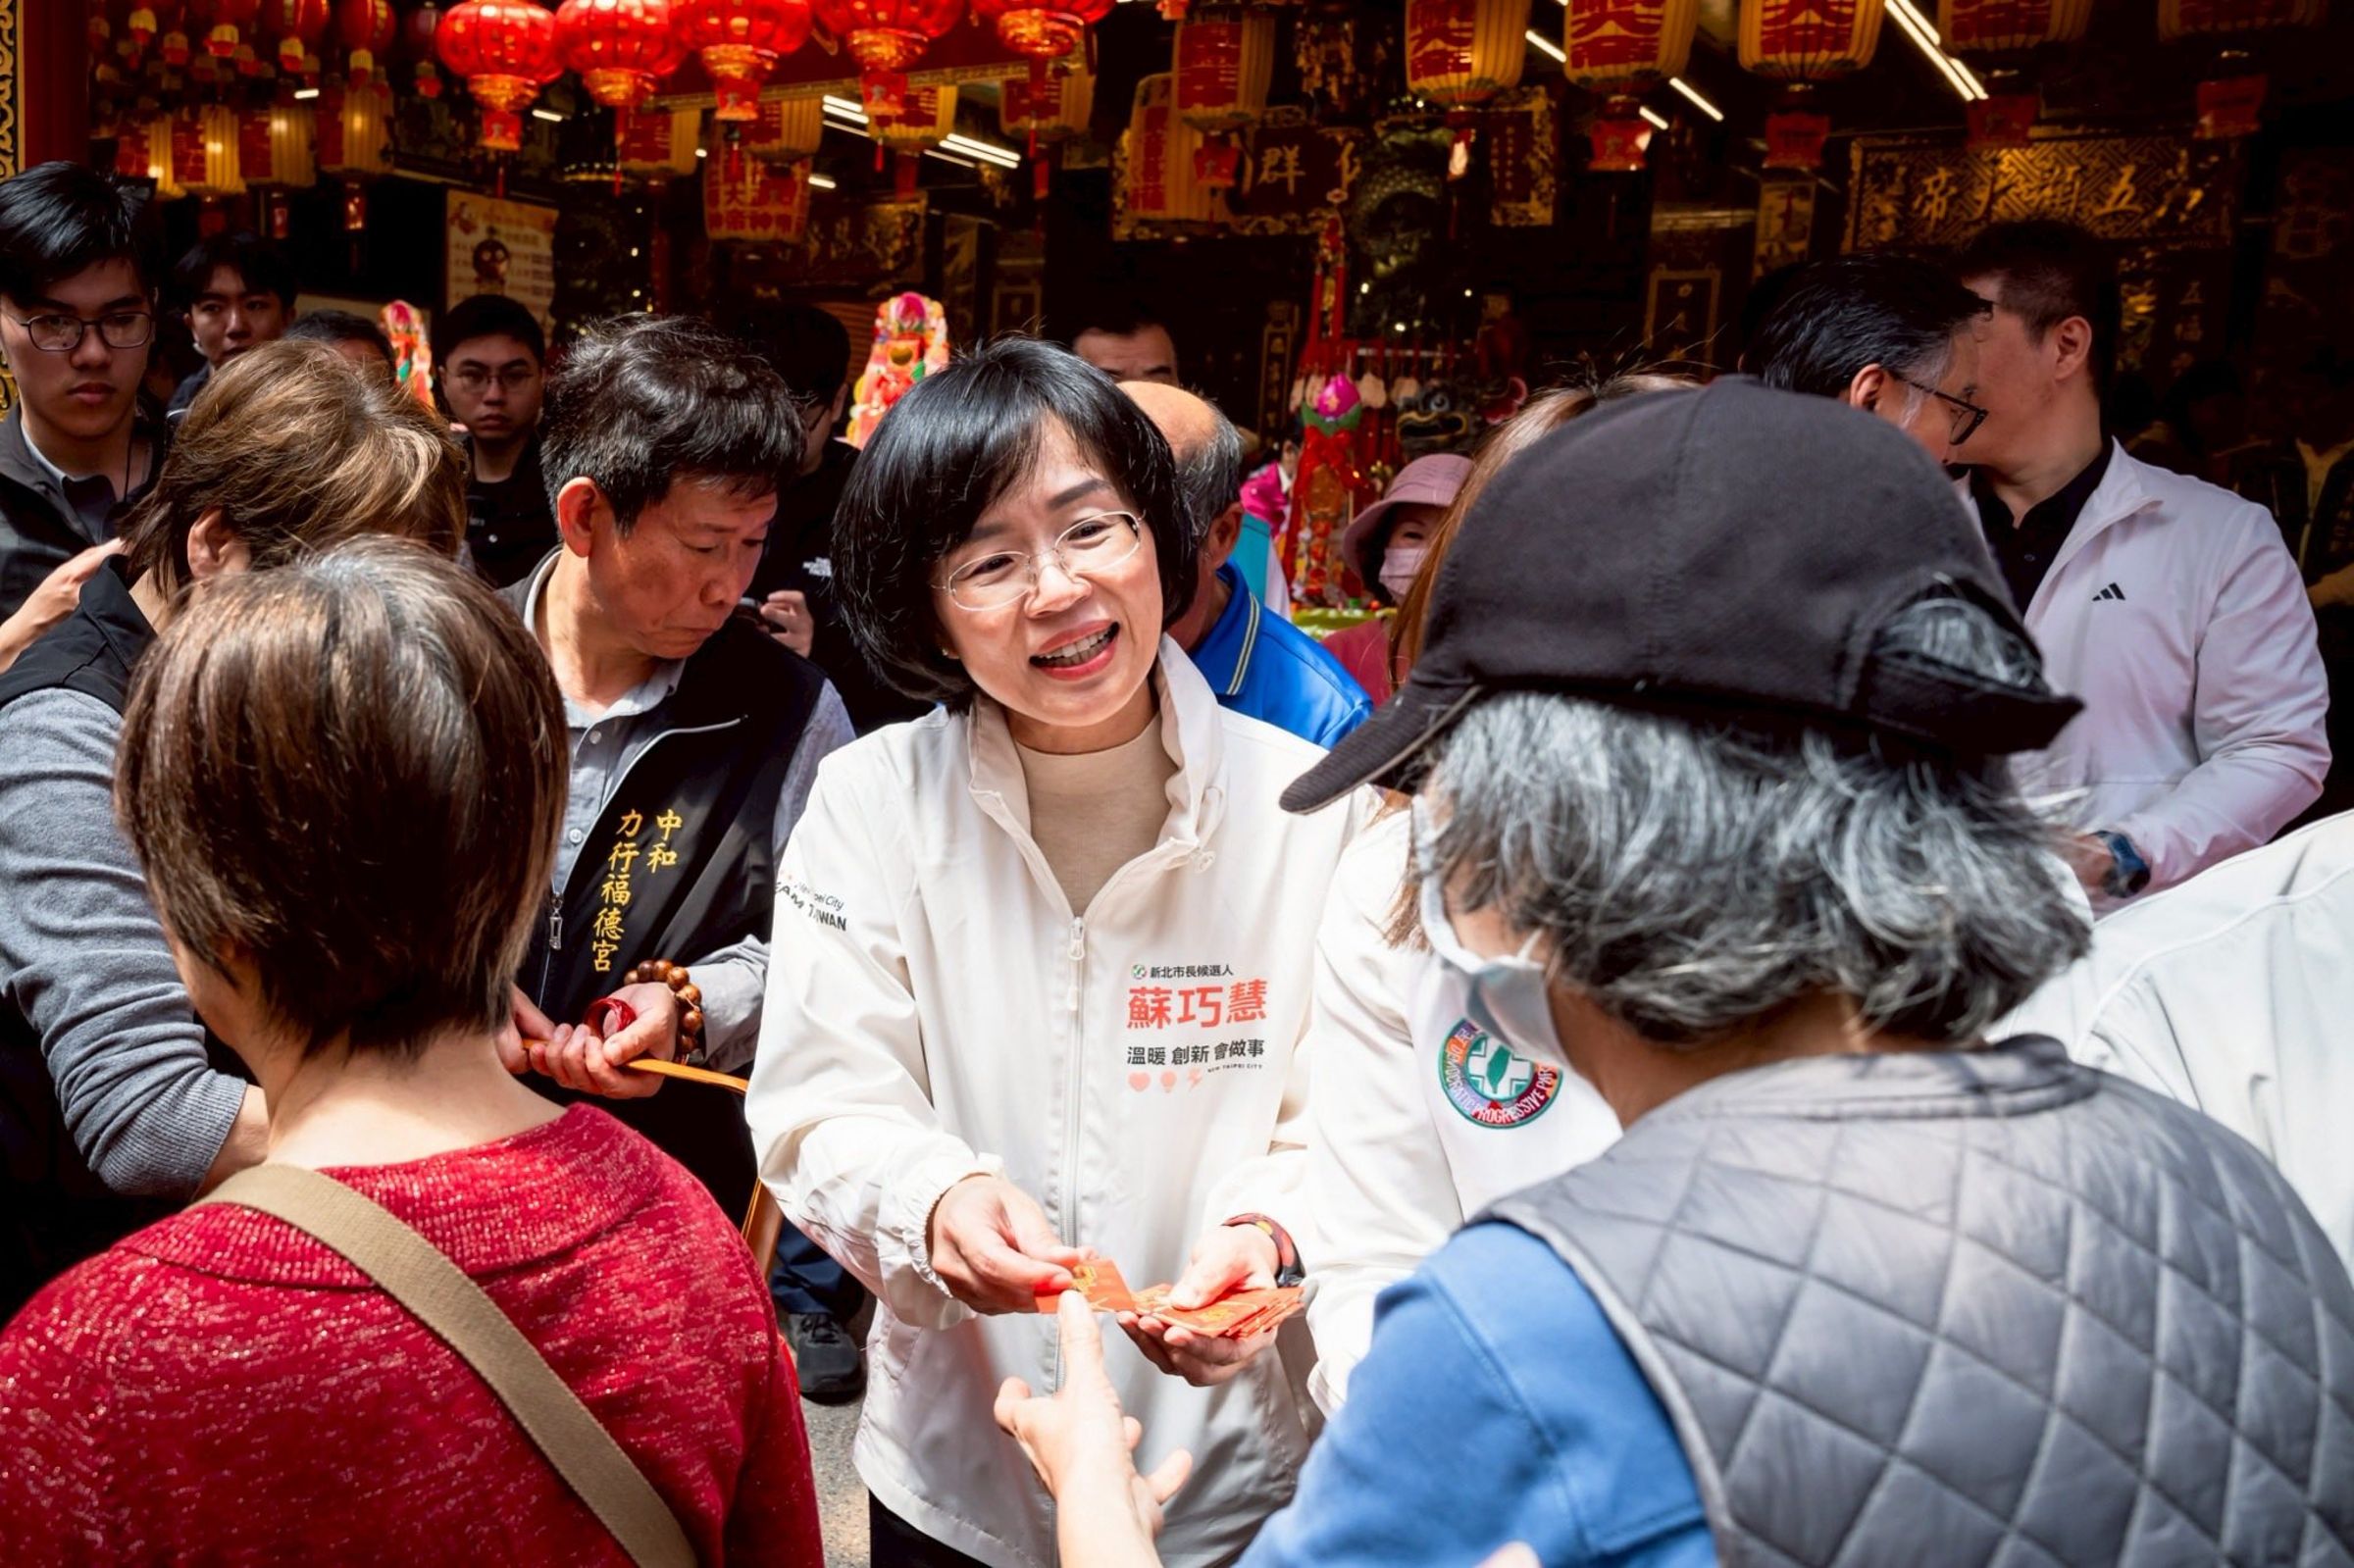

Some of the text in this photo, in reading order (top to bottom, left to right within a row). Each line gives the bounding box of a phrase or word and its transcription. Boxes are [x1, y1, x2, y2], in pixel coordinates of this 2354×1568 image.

[646, 808, 684, 874] 中和
[591, 809, 644, 973] 力行福德宮
[1150, 964, 1234, 979] 新北市長候選人
[1127, 979, 1268, 1030] 蘇巧慧
[1127, 1038, 1265, 1066] 溫暖 創新 會做事
[1472, 1088, 1546, 1124] PROGRESSIVE
